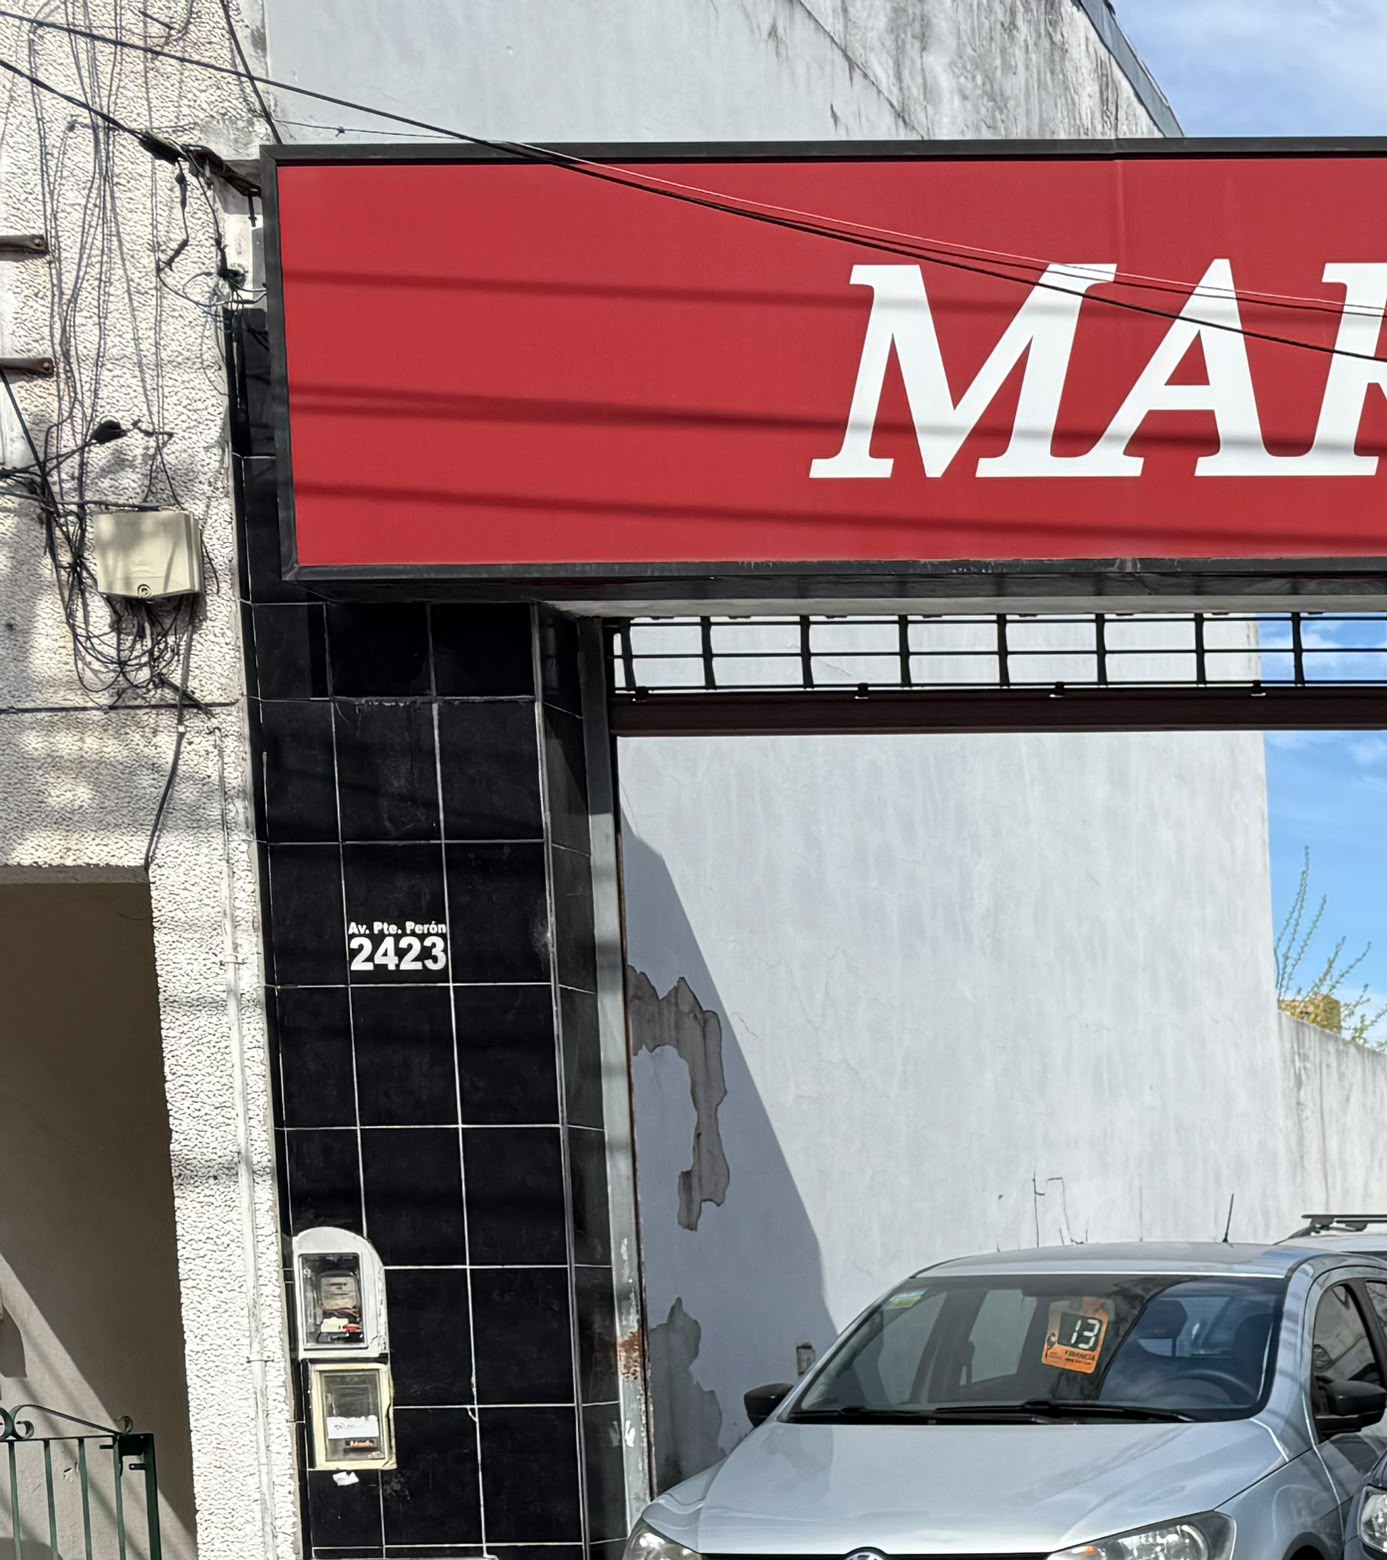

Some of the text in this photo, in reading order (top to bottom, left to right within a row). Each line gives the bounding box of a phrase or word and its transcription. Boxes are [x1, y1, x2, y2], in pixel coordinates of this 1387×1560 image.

[348, 920, 447, 935] Av. Pte. Perón
[350, 936, 447, 971] 2423
[1070, 1318, 1101, 1350] 13
